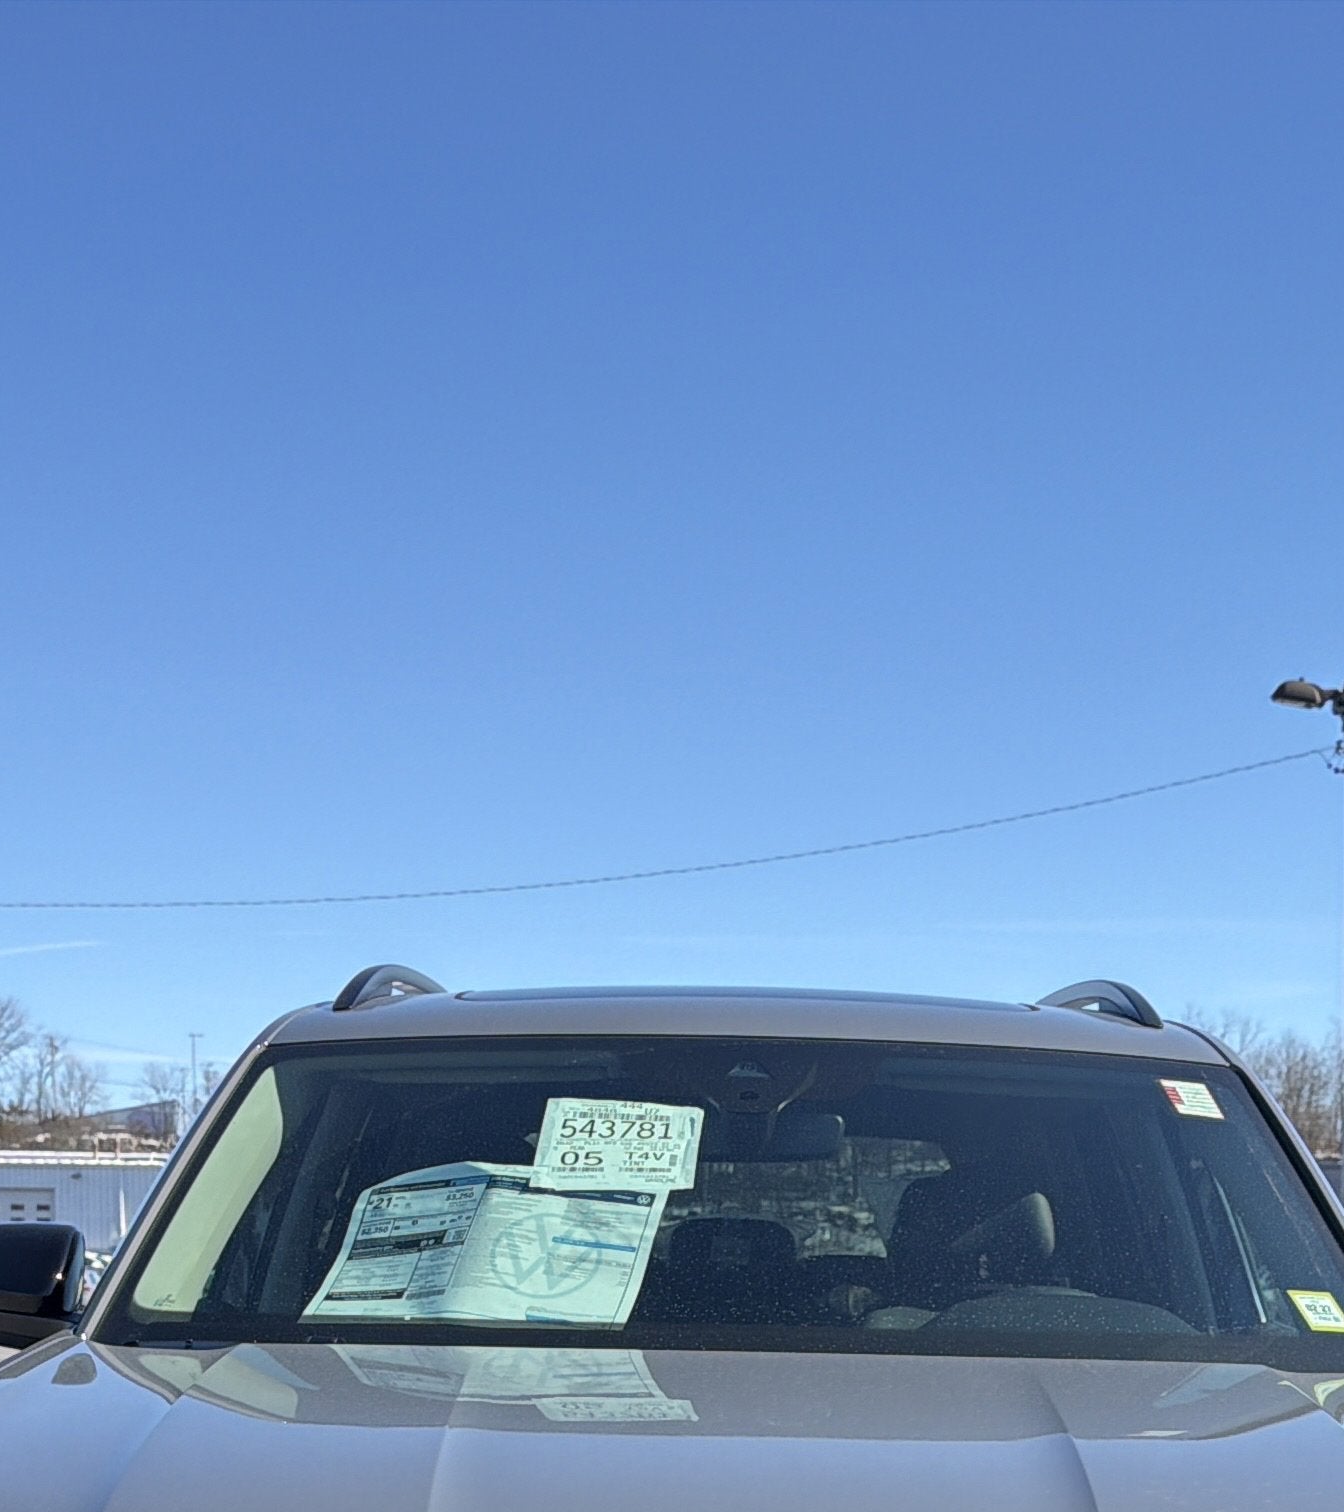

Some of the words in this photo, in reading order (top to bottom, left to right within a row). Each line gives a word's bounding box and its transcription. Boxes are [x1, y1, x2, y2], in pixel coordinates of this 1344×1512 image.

[559, 1118, 673, 1140] 543781
[560, 1151, 604, 1166] 05
[623, 1151, 665, 1161] T4V
[373, 1196, 393, 1210] 21
